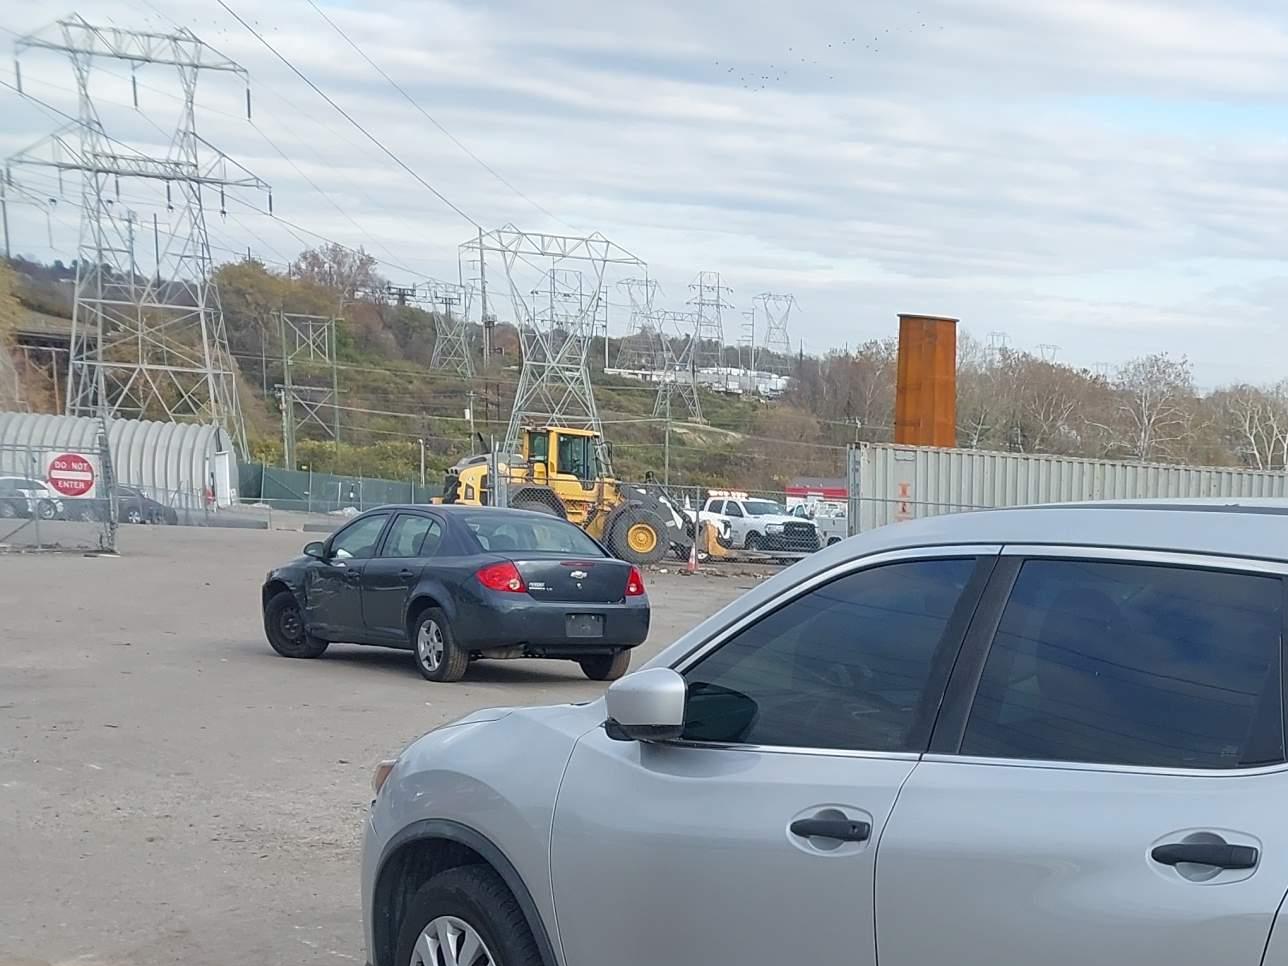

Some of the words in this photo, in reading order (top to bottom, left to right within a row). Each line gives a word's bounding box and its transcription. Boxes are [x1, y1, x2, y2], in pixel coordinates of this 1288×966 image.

[54, 461, 67, 469] DO
[72, 462, 88, 470] NOT
[58, 481, 85, 489] ENTER
